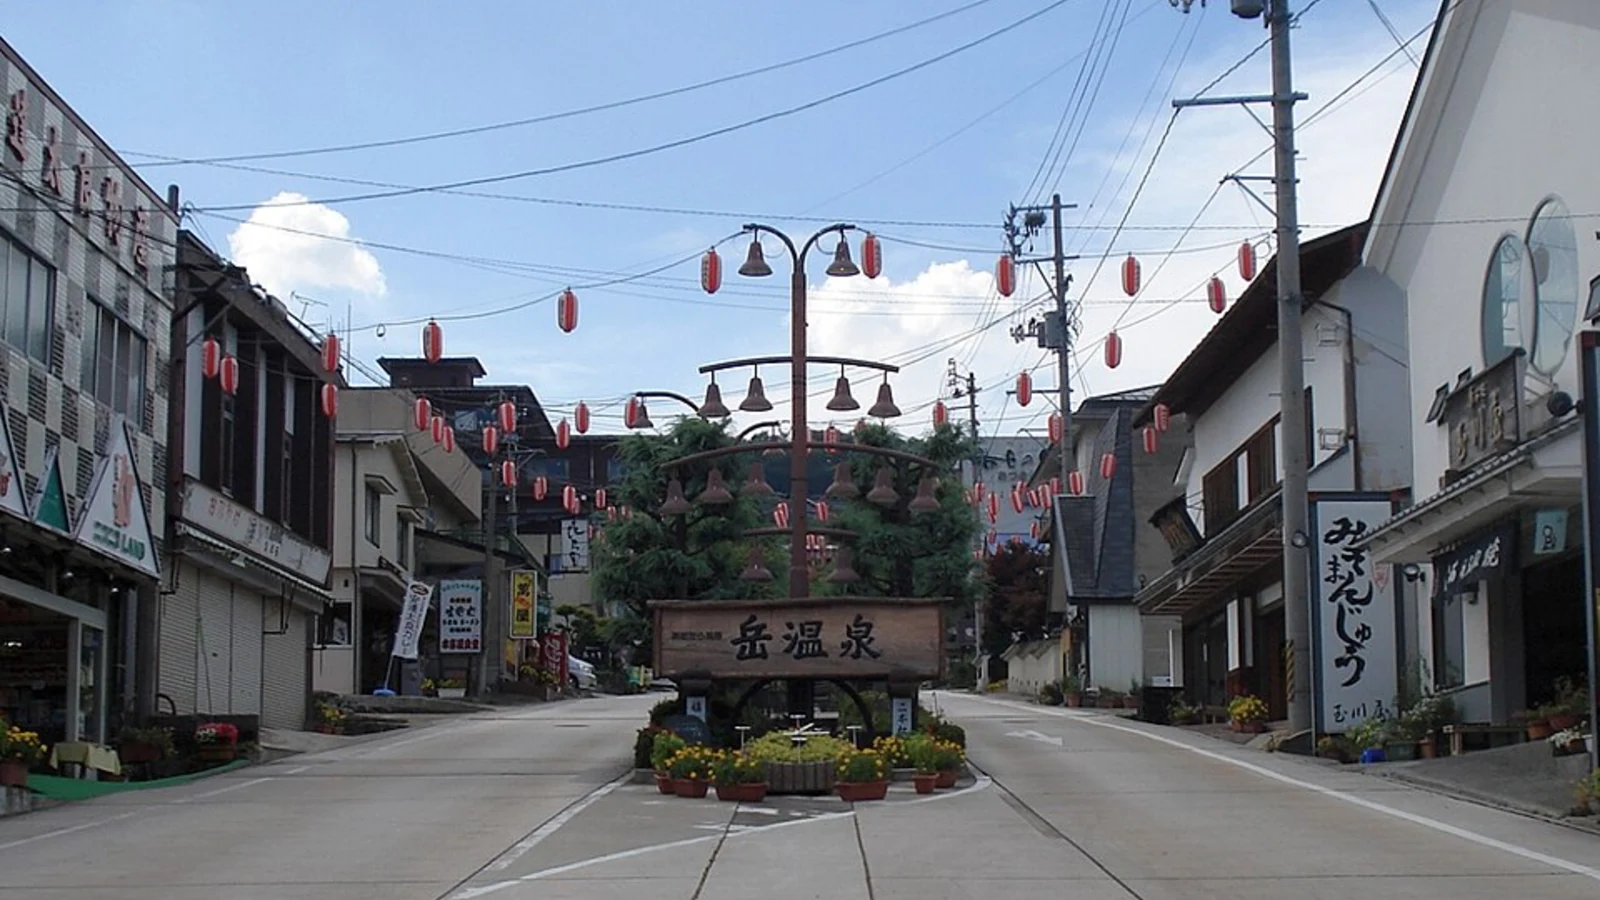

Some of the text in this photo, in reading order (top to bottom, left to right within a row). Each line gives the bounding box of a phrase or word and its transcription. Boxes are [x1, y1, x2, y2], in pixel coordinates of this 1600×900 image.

[1323, 517, 1374, 687] みそまんじゅう
[730, 614, 881, 661] 岳温泉
[1333, 699, 1391, 723] 玉川屋
